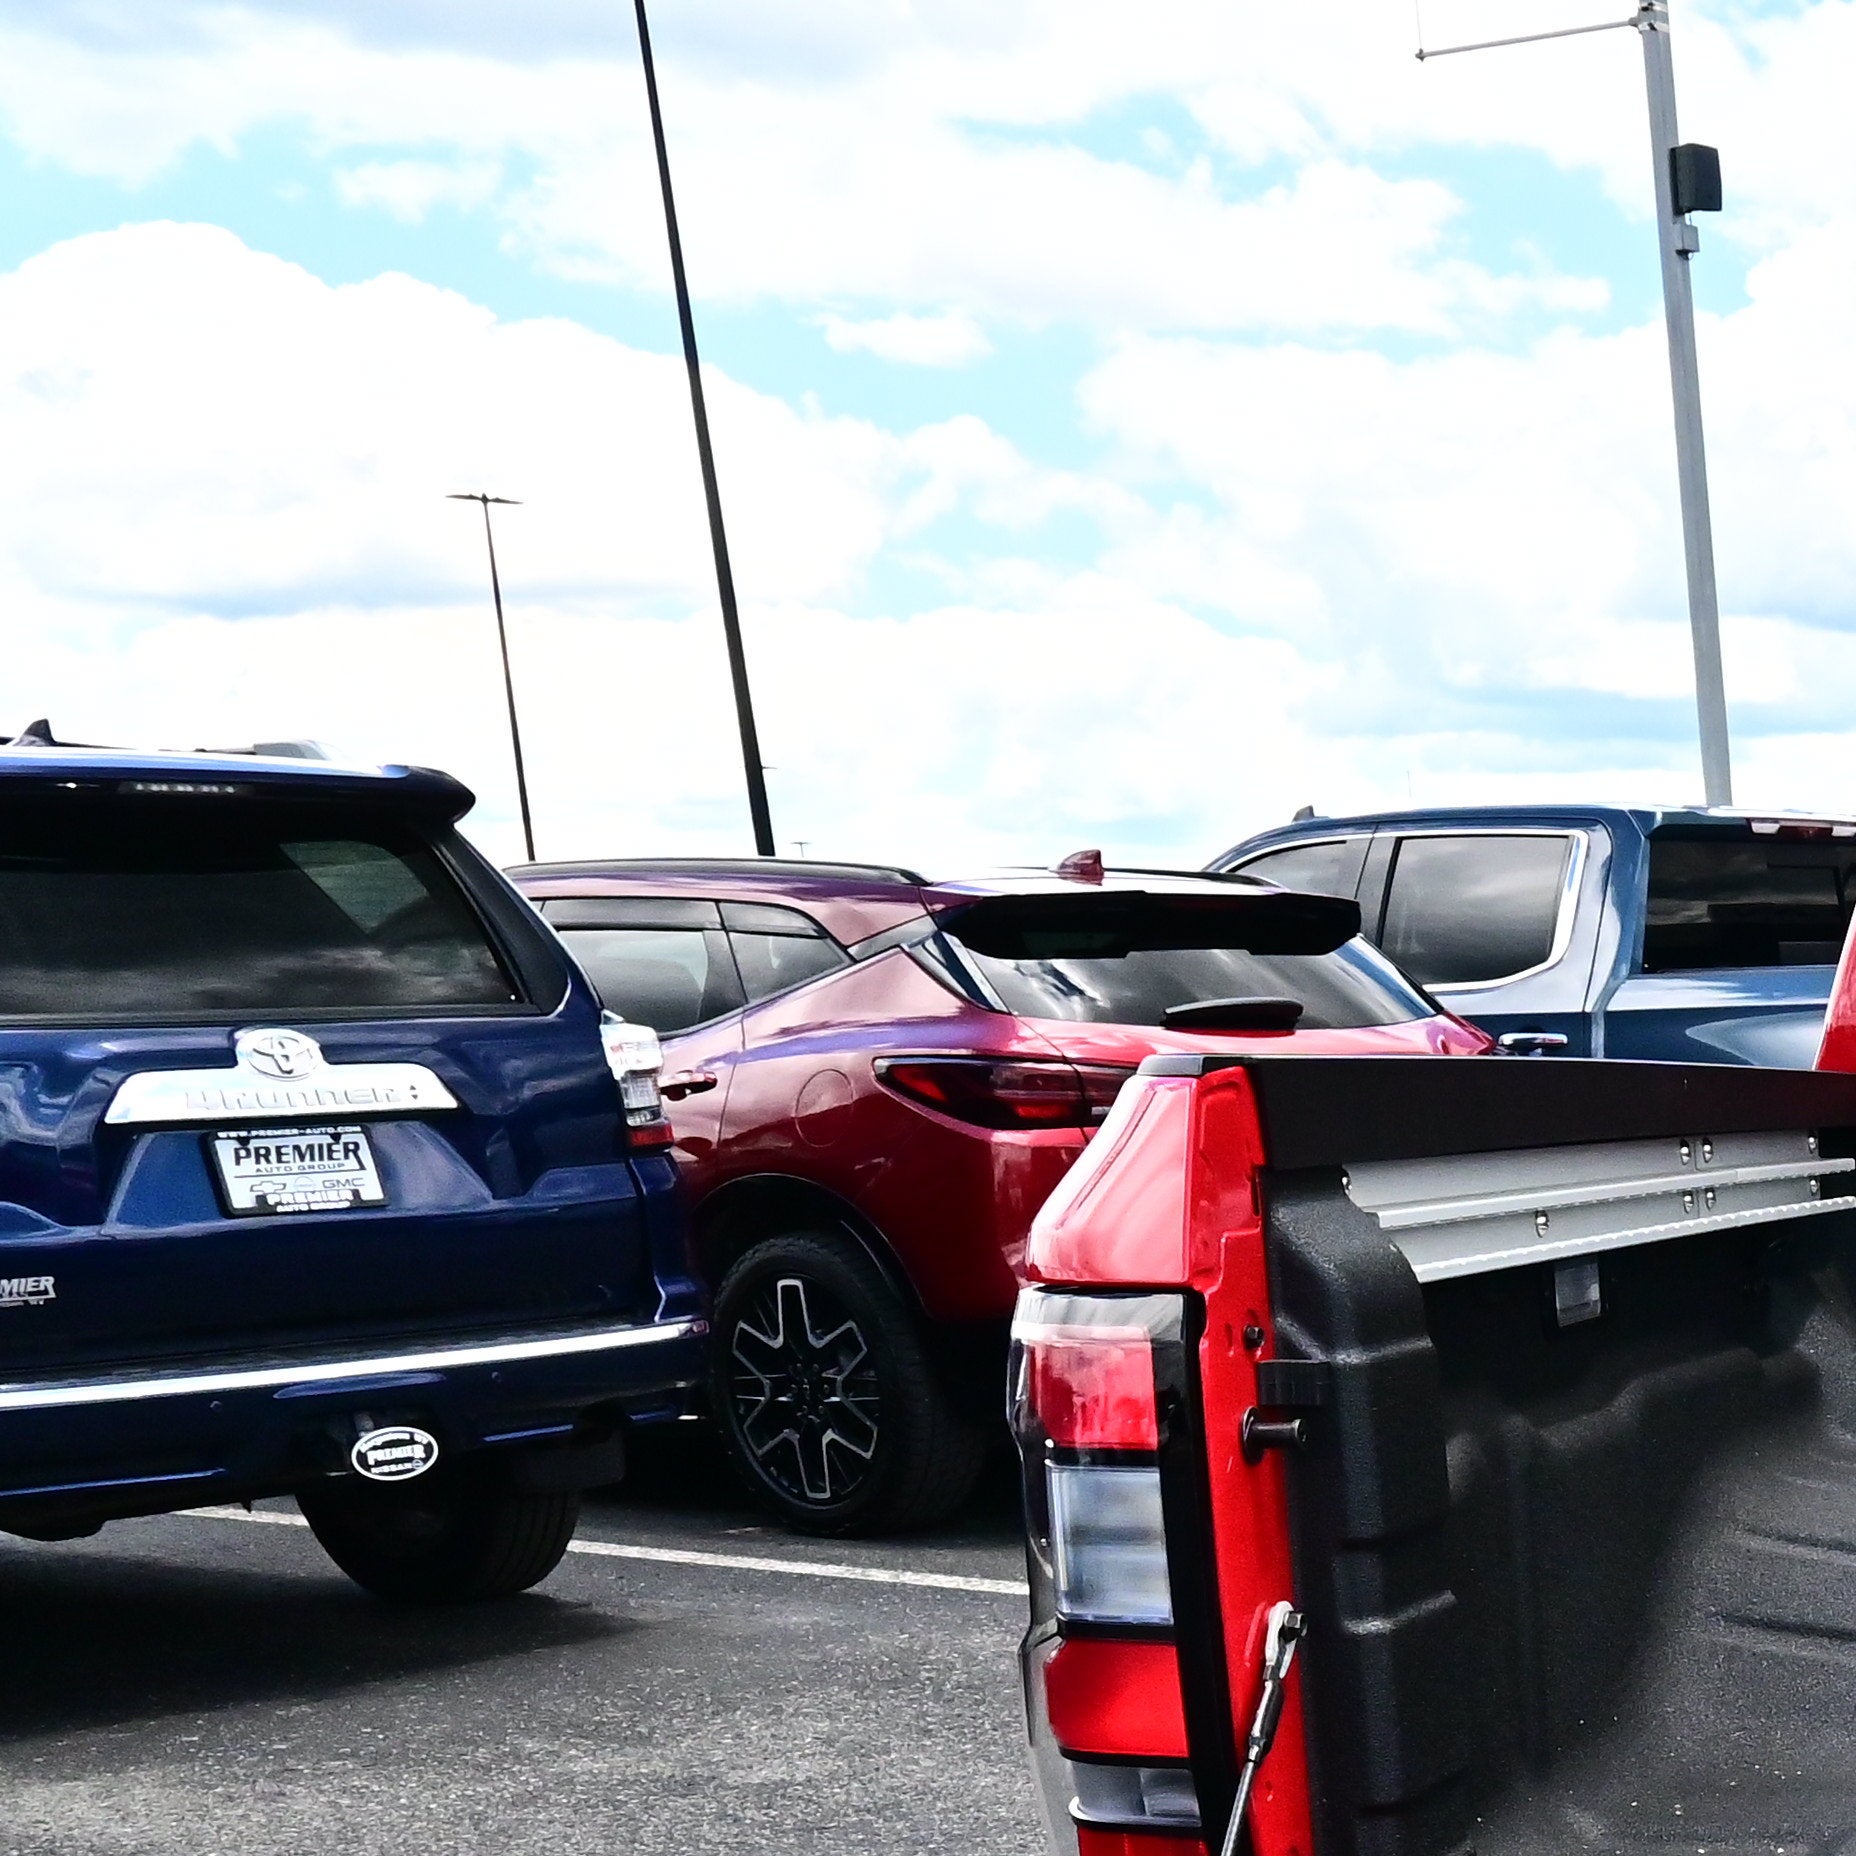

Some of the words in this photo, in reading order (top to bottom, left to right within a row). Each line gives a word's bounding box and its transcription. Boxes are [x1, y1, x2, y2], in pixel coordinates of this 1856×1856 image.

[233, 1141, 366, 1171] PREMIER
[297, 1163, 346, 1171] GROUP
[322, 1178, 365, 1188] GMC
